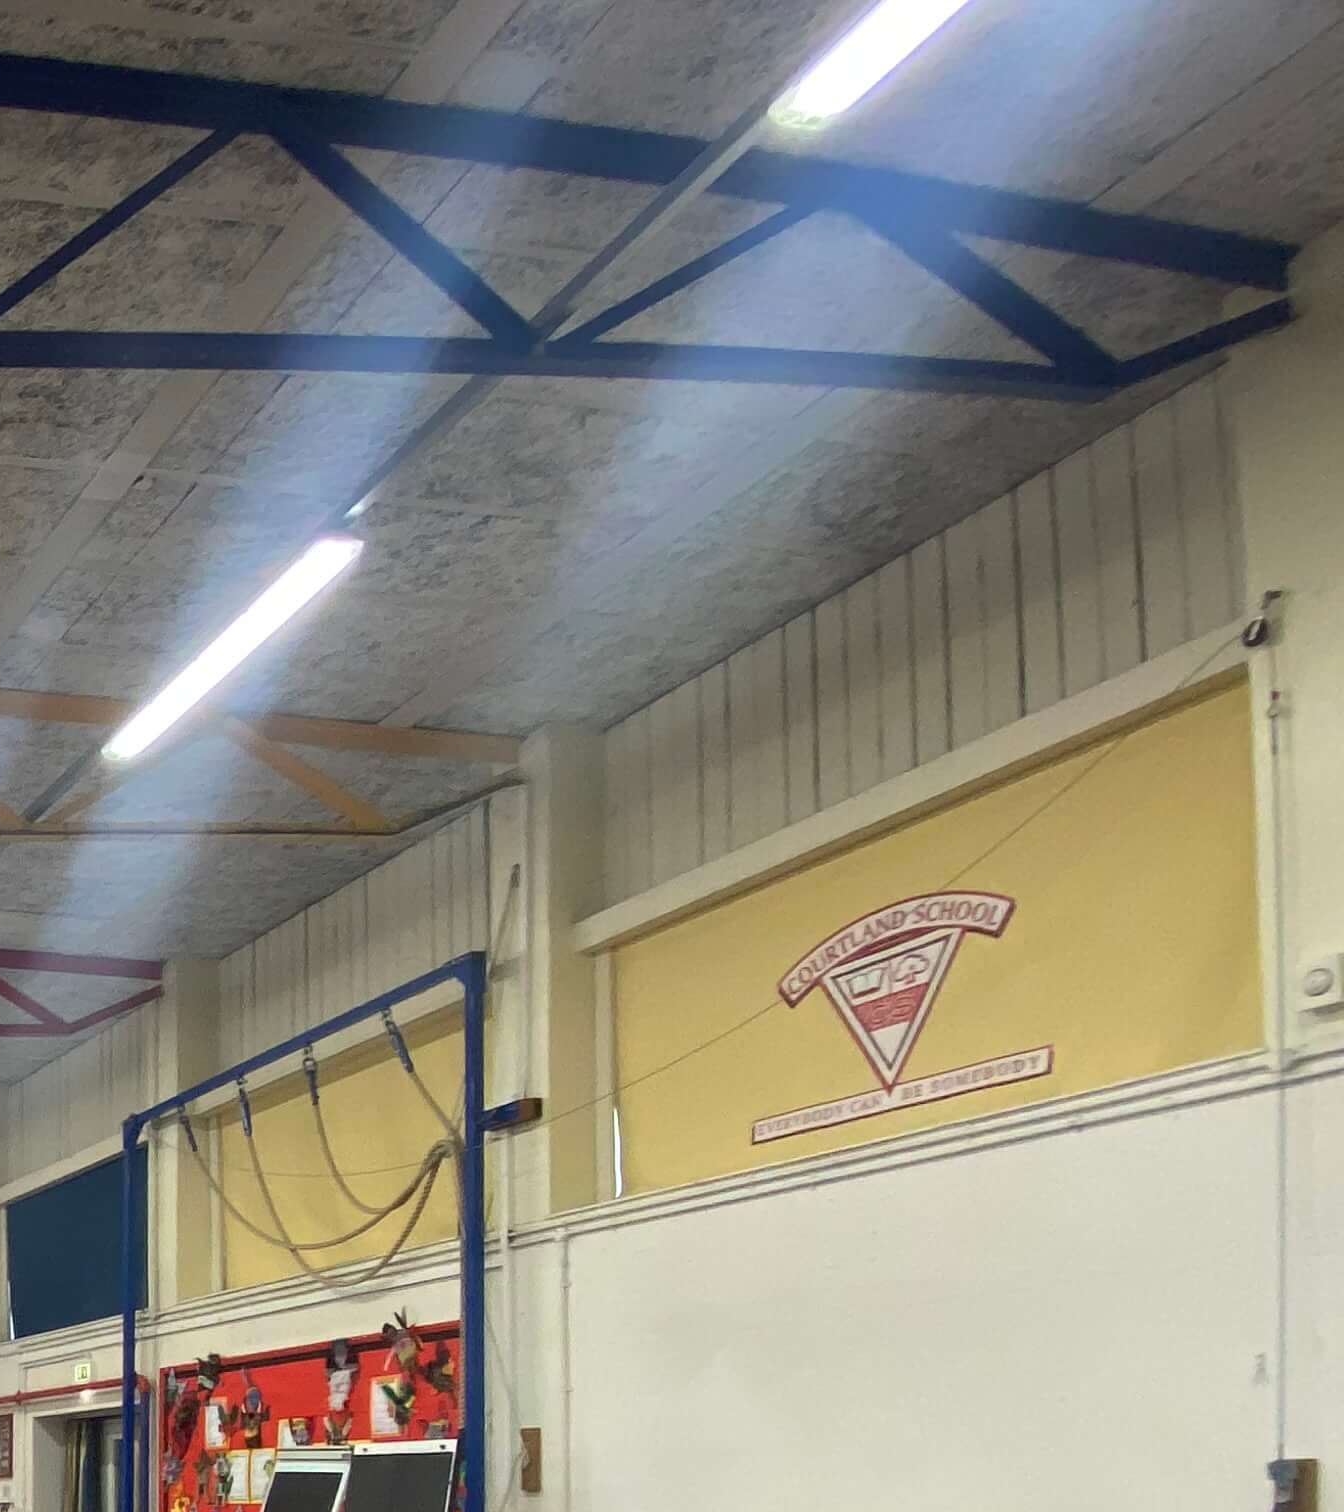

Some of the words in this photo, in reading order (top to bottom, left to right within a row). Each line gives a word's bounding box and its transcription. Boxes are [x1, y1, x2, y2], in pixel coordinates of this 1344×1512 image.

[787, 910, 906, 995] COURTLAND
[912, 901, 1000, 927] SCHOOL
[756, 1105, 845, 1138] EVERYBODY
[900, 1083, 923, 1101] BE
[929, 1054, 1042, 1094] SOMEBODY
